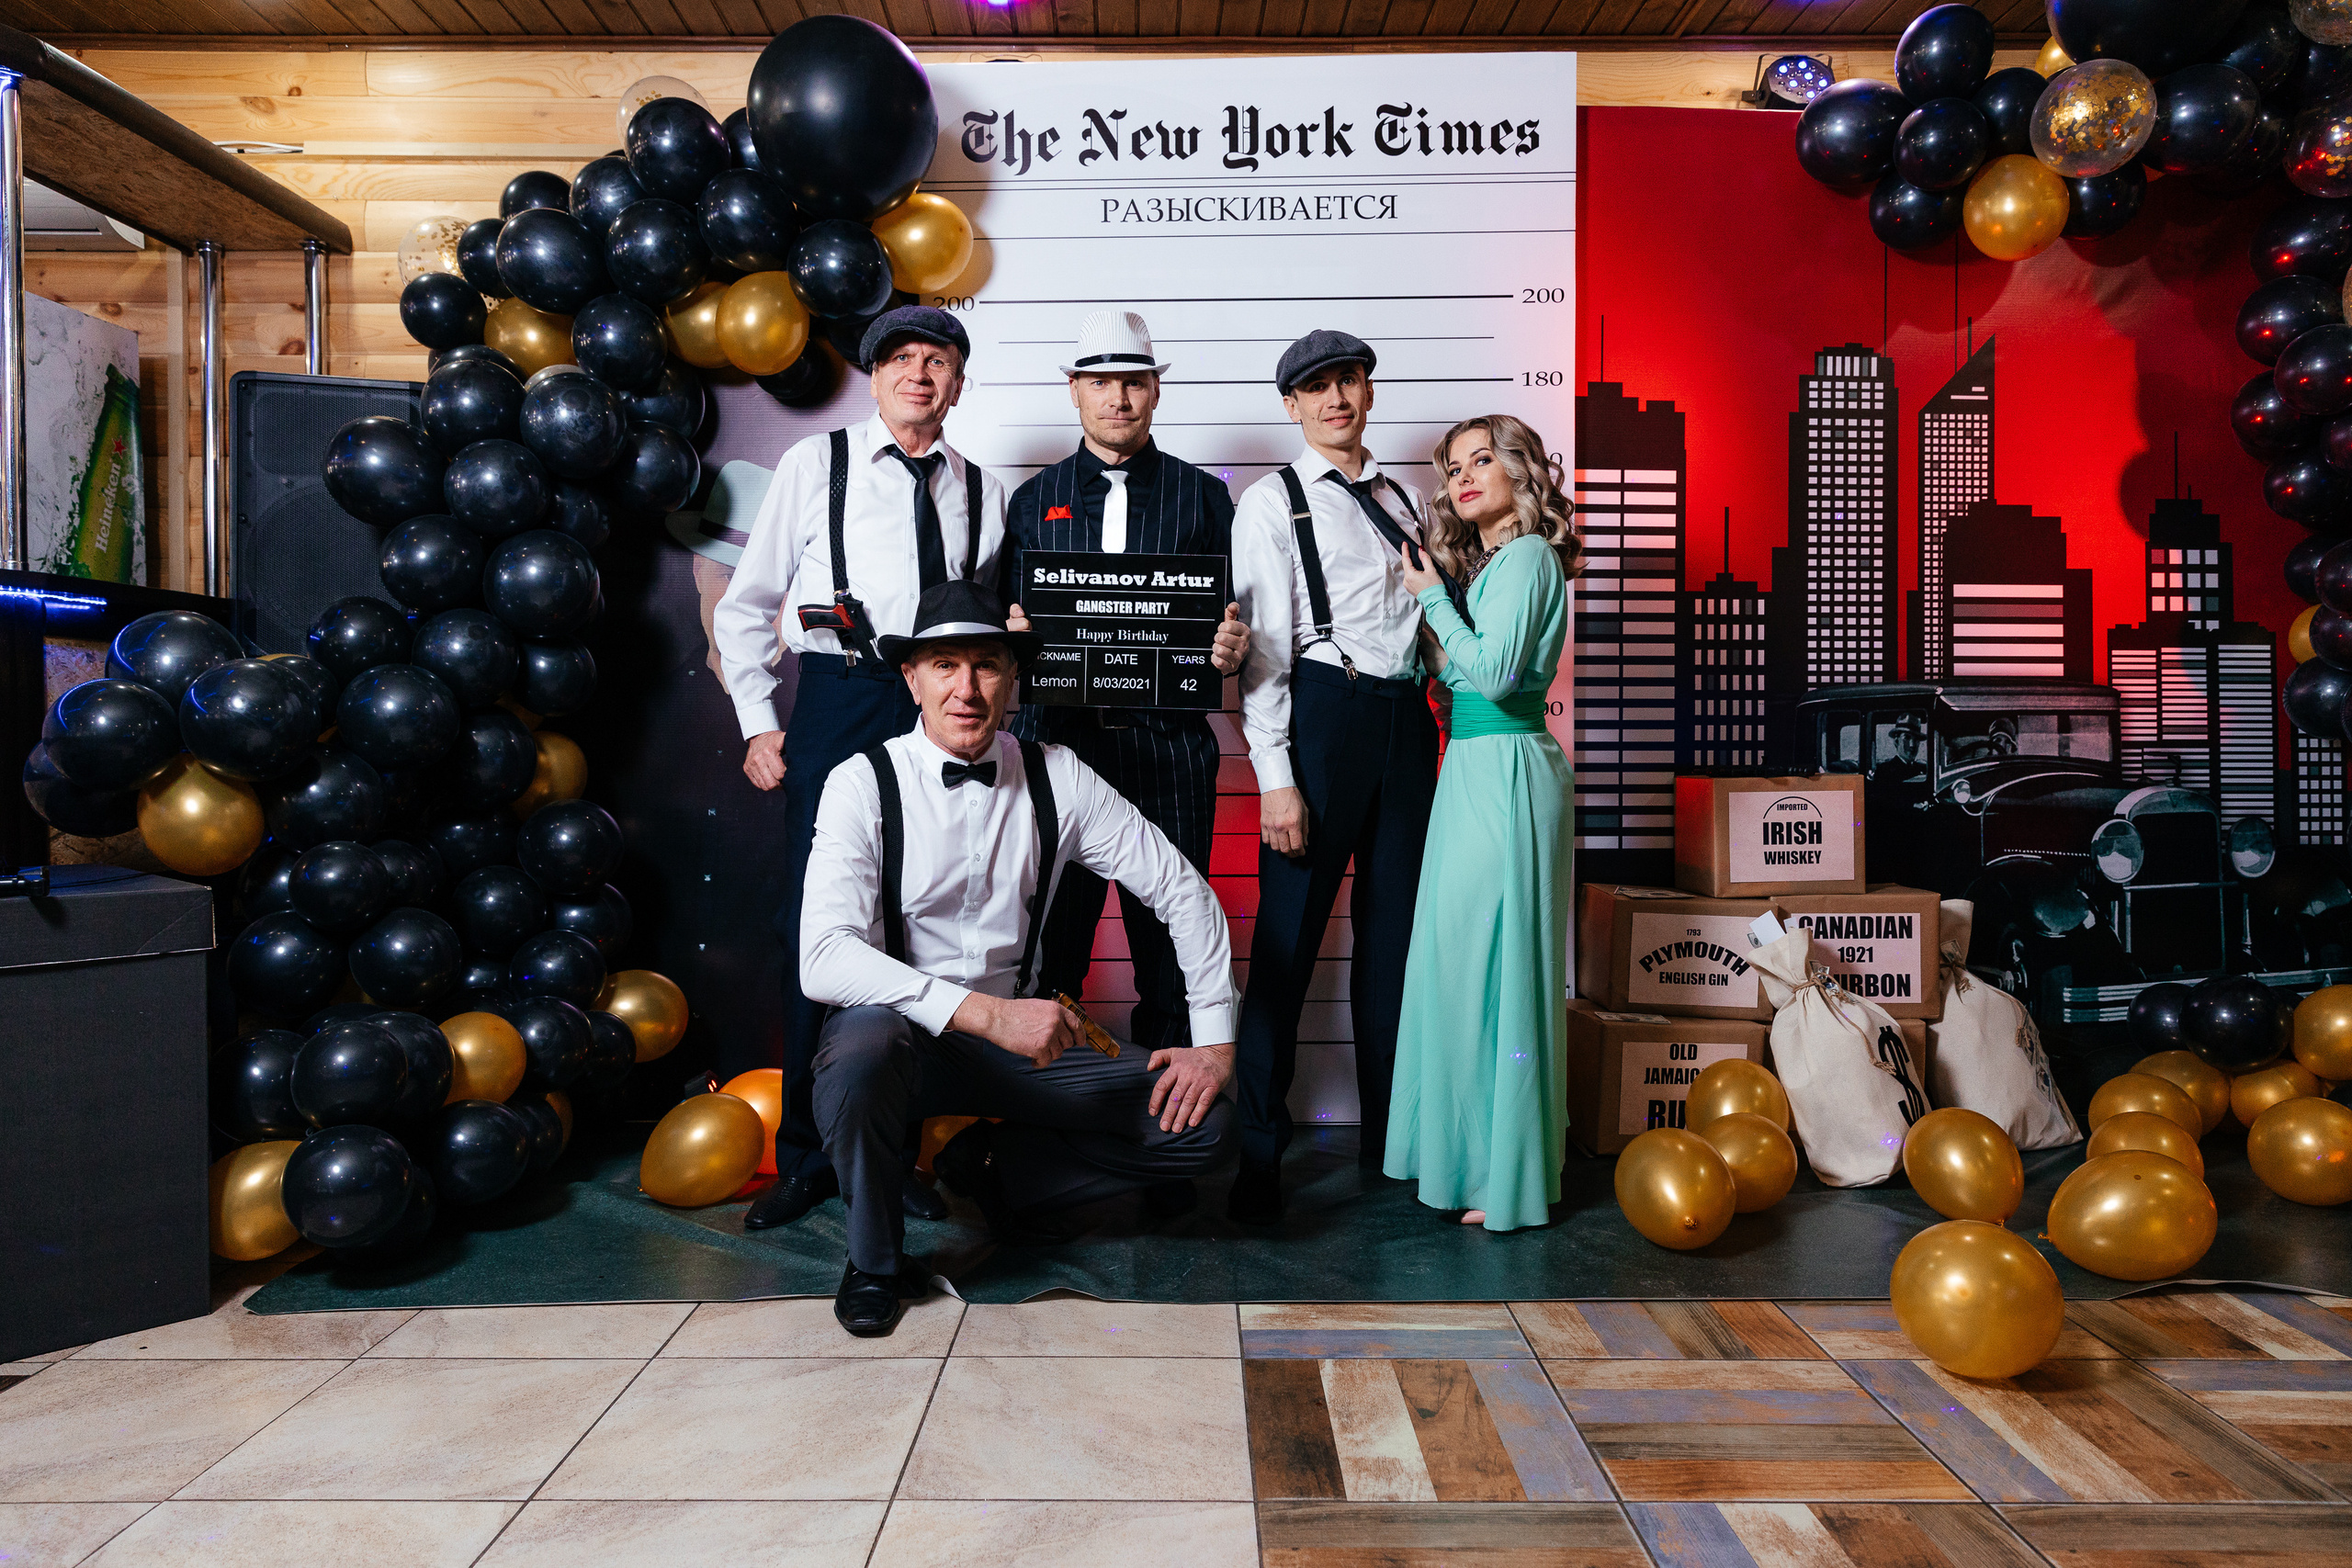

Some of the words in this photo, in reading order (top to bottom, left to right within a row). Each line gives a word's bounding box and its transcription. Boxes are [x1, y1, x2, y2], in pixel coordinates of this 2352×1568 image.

[961, 109, 1061, 176] The
[1079, 107, 1202, 168] New
[1222, 105, 1356, 173] York
[1374, 102, 1540, 158] Times
[1101, 195, 1398, 224] РАЗЫСКИВАЕТСЯ
[933, 296, 975, 311] 200
[1521, 288, 1566, 304] 200
[1521, 370, 1564, 387] 180
[95, 463, 121, 553] Heineken
[1034, 568, 1147, 586] Selivanov
[1150, 570, 1215, 588] Artur
[1075, 599, 1133, 615] GANGSTER
[1135, 601, 1170, 615] PARTY
[1075, 627, 1114, 643] Happy
[1117, 629, 1170, 644] Birthday
[1104, 653, 1138, 665] DATE
[1171, 655, 1205, 665] YEARS
[1032, 674, 1077, 688] Lemon
[1092, 677, 1150, 690] 8/03/2021
[1180, 678, 1197, 692] 42
[1776, 803, 1808, 811] IMPORTED
[1762, 820, 1823, 846] IRISH
[1763, 850, 1822, 865] WHISKEY
[1686, 929, 1702, 937] 1793
[1638, 941, 1751, 977] PLYMOUTH
[1837, 946, 1873, 963] 1921
[1658, 971, 1706, 986] ENGLISH
[1708, 973, 1729, 987] GIN
[1668, 1043, 1698, 1061] OLD
[1644, 1067, 1705, 1085] JAMAIC
[1646, 1099, 1686, 1132] RU
